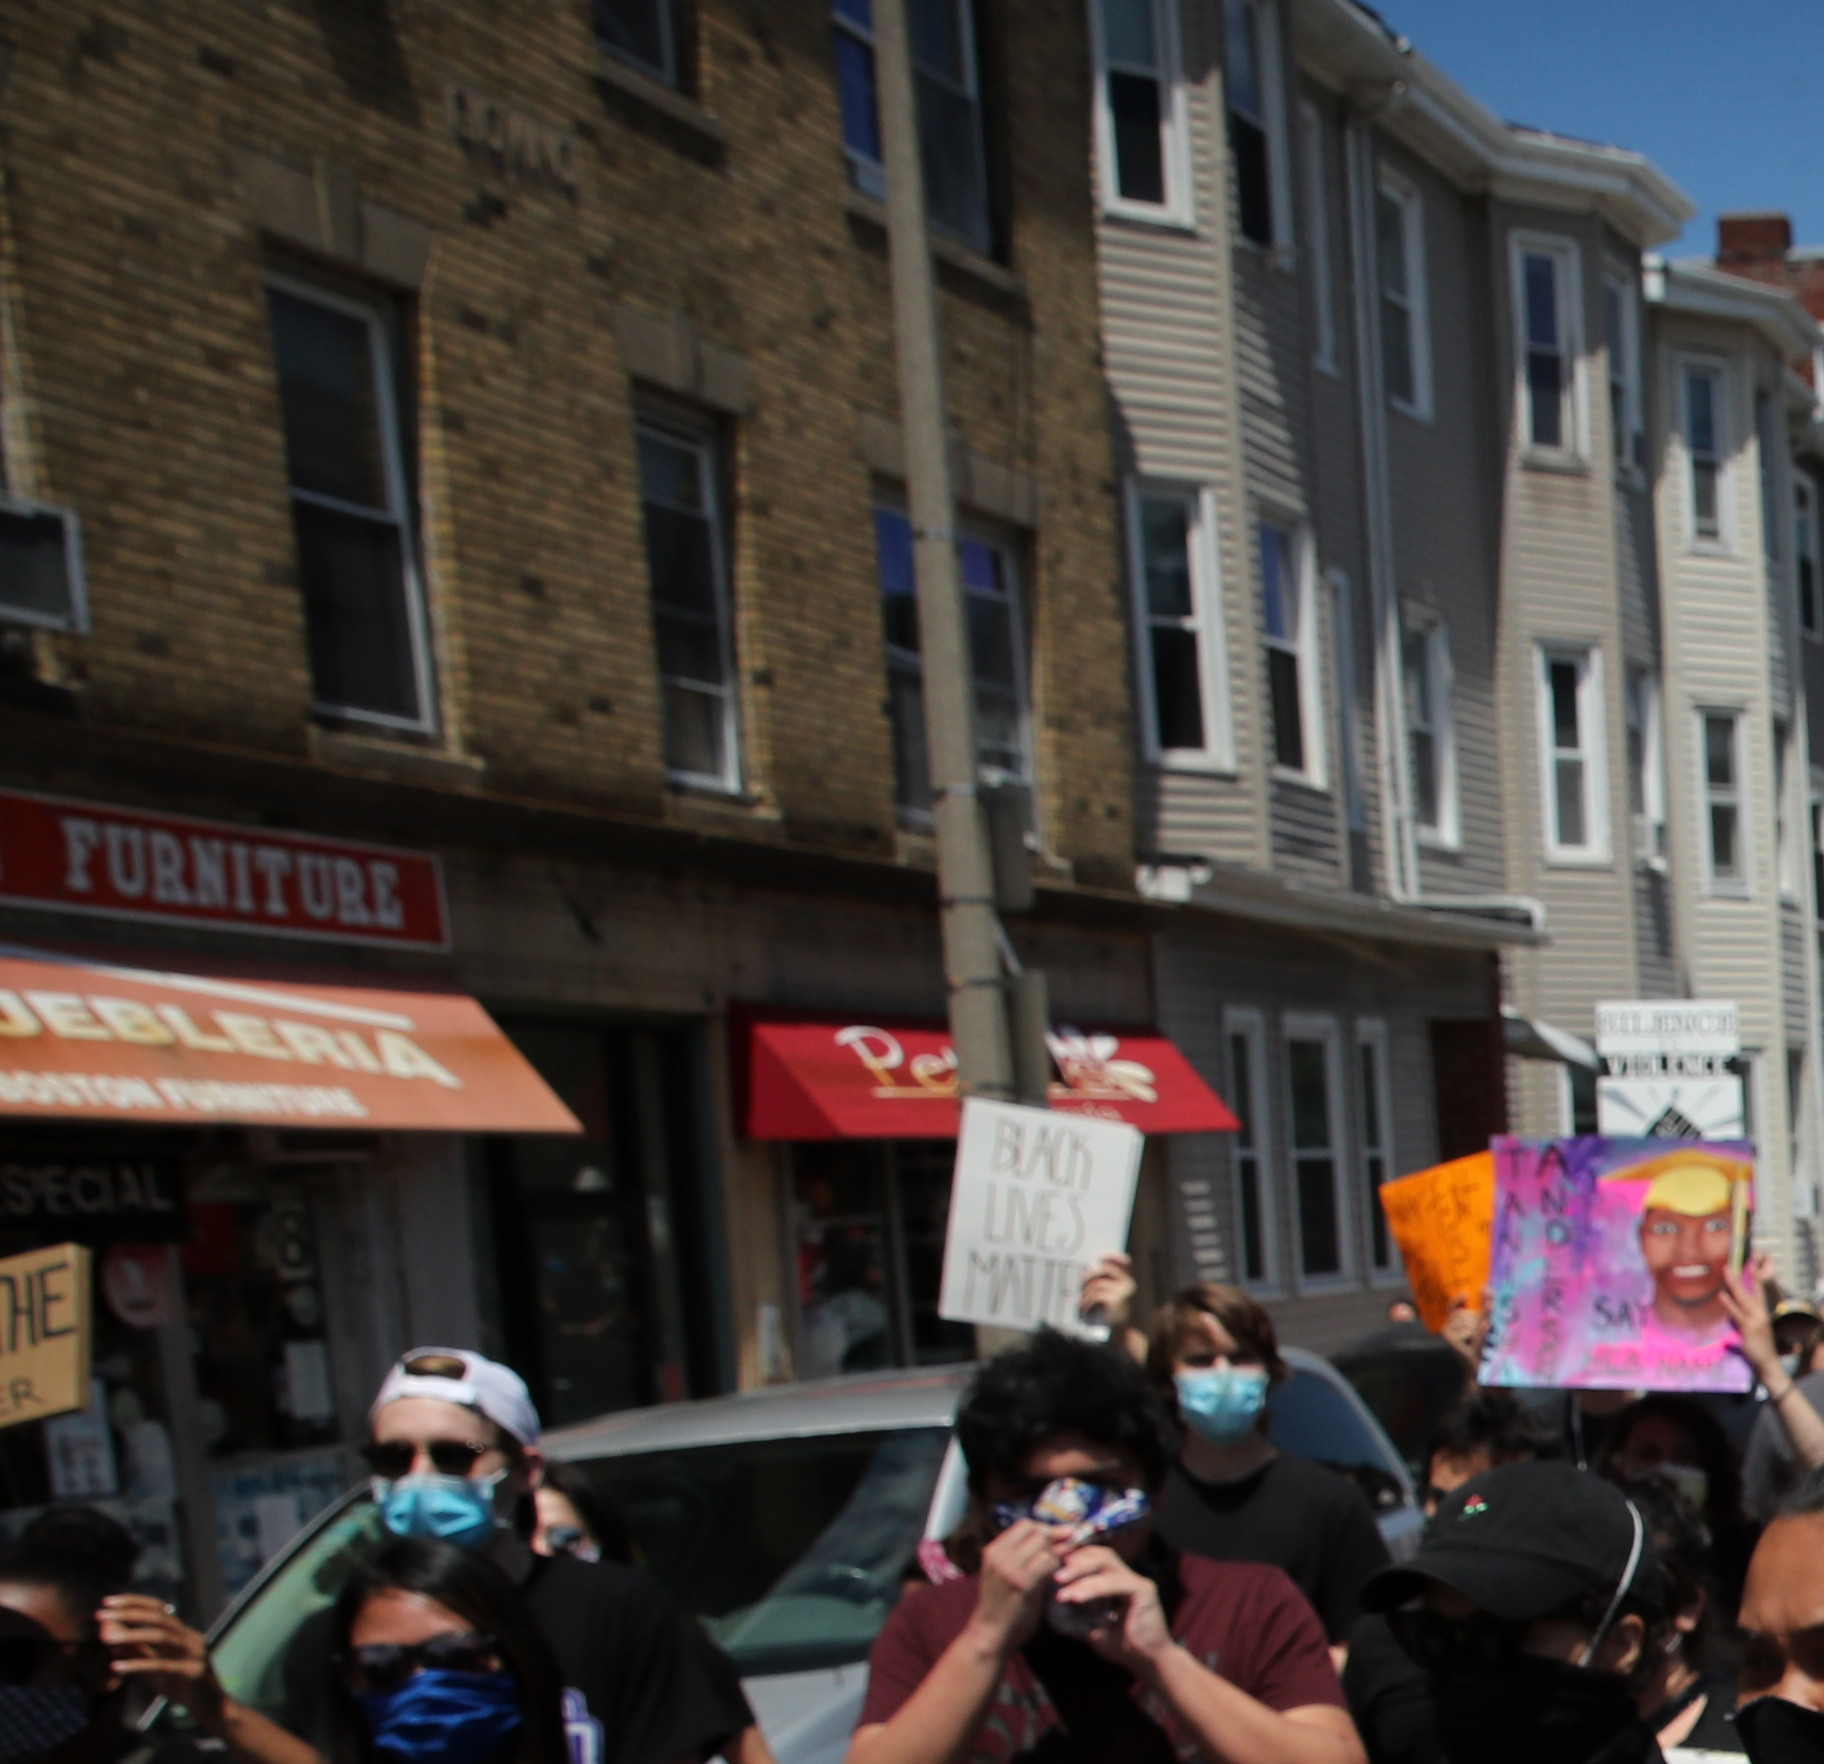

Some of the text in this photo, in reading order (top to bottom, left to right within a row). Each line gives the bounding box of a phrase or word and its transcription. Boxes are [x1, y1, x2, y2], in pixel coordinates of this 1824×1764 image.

[59, 815, 404, 930] FURNITURE
[992, 1114, 1093, 1193] BLACK
[984, 1182, 1087, 1257] LIVES
[0, 1261, 78, 1356] HE
[966, 1249, 1088, 1322] MATTE
